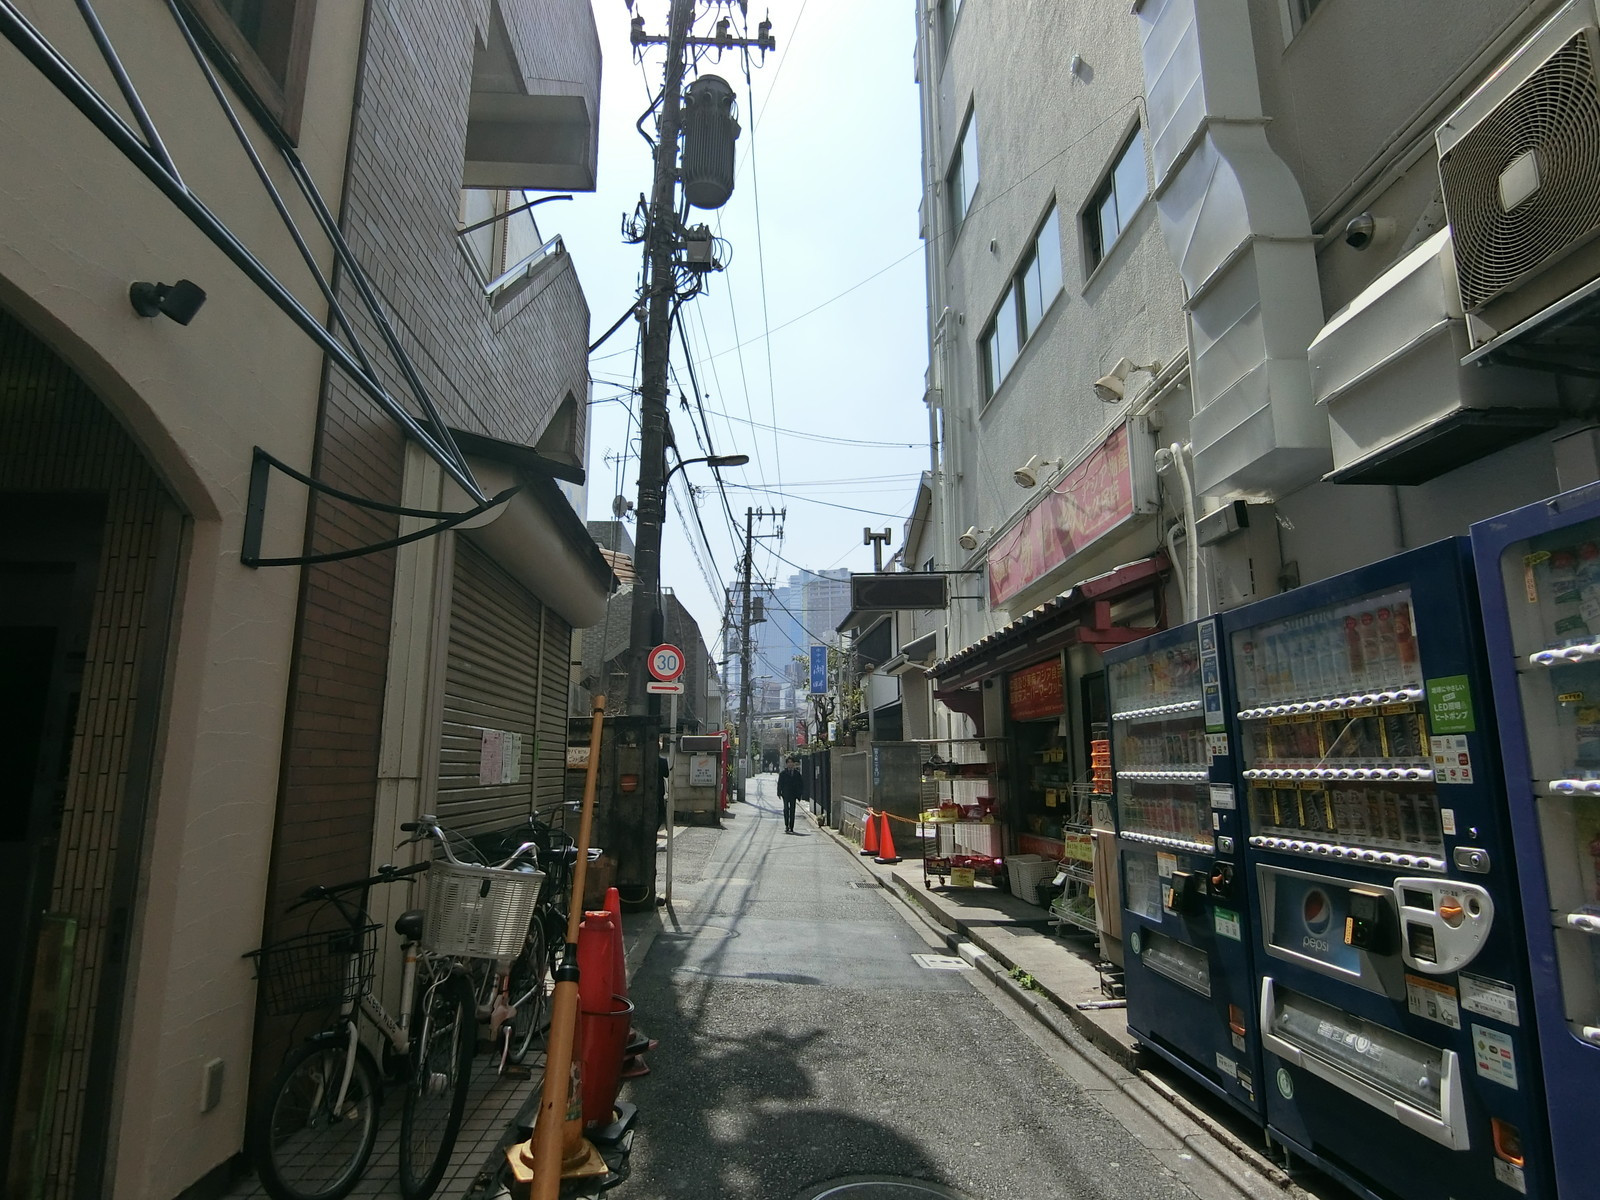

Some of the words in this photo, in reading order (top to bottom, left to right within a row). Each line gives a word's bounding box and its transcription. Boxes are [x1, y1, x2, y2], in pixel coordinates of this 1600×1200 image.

[656, 654, 677, 671] 30
[1435, 711, 1468, 721] ヒートポンプ
[1302, 935, 1329, 952] pepsi
